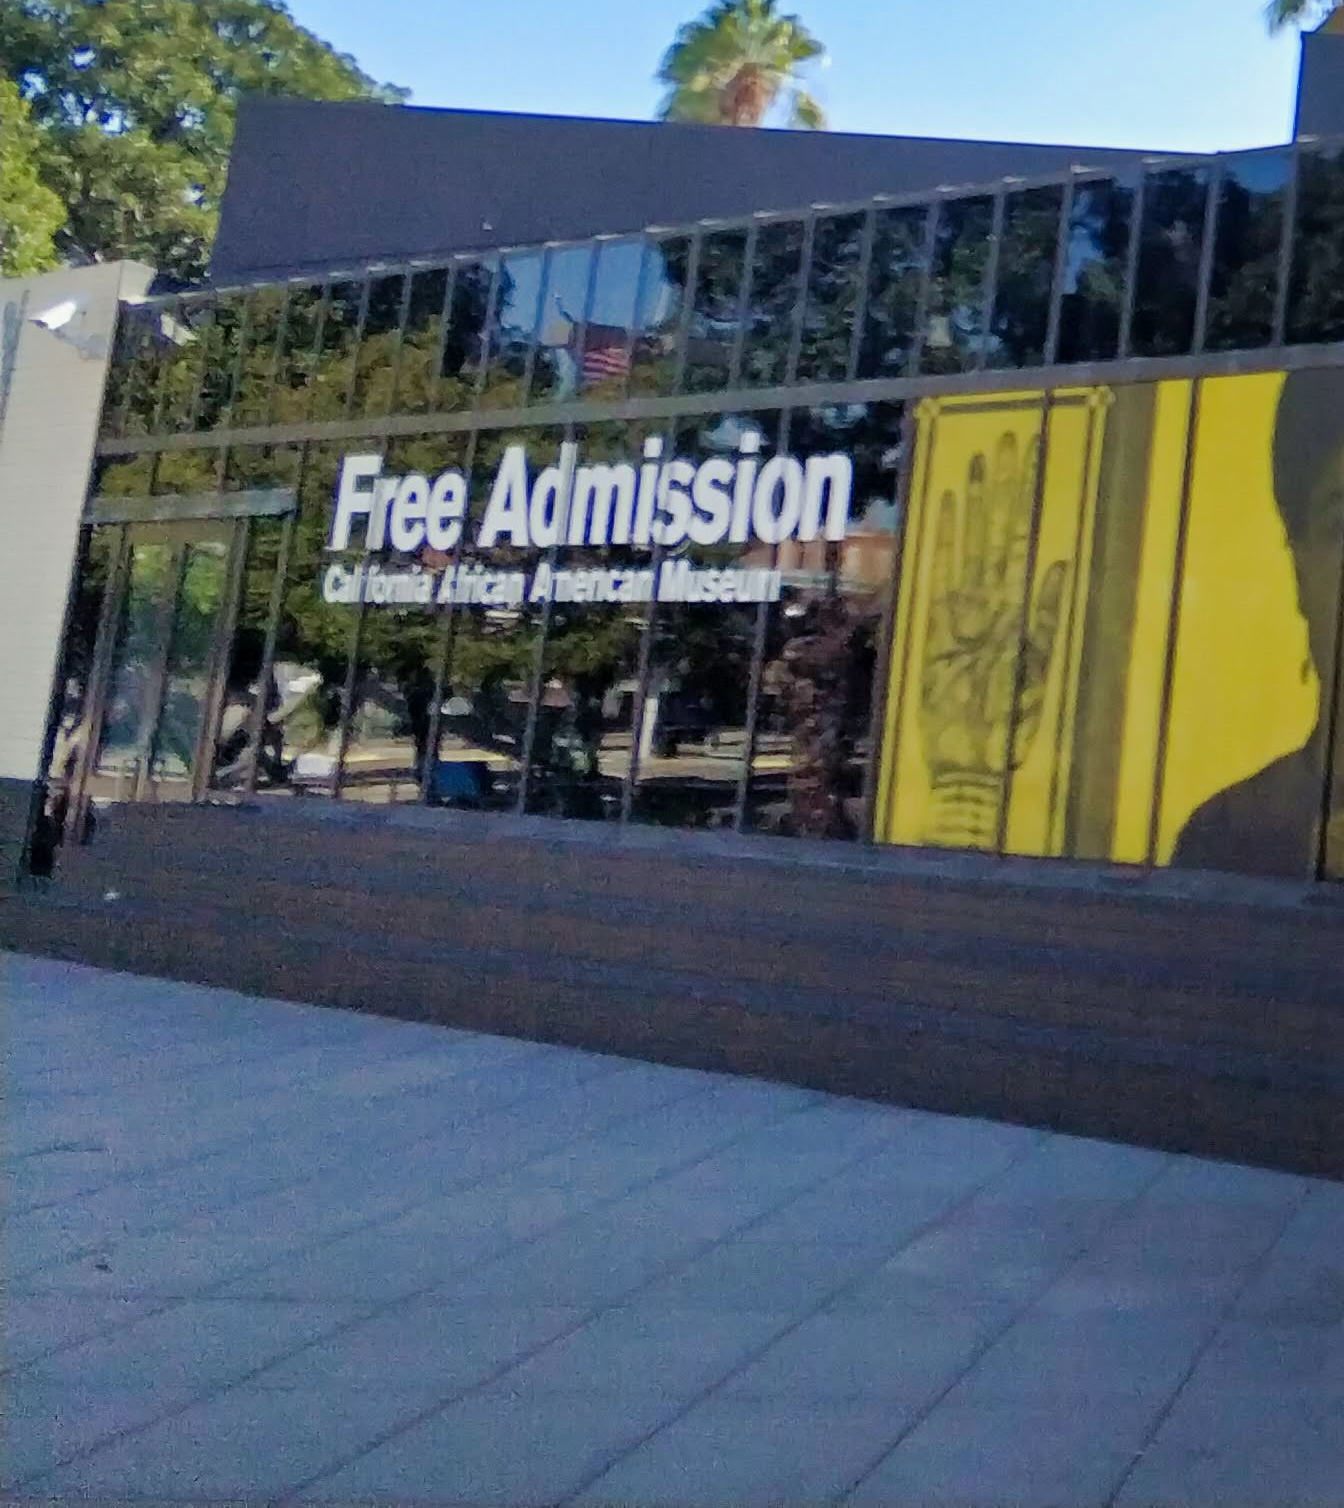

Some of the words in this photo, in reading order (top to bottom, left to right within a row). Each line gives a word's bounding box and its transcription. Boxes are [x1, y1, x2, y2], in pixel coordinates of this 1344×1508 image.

[327, 453, 468, 553] Free
[476, 430, 855, 549] Admission
[322, 563, 434, 604] California
[435, 563, 526, 605] African
[529, 561, 654, 604] American
[655, 559, 781, 603] Museum
